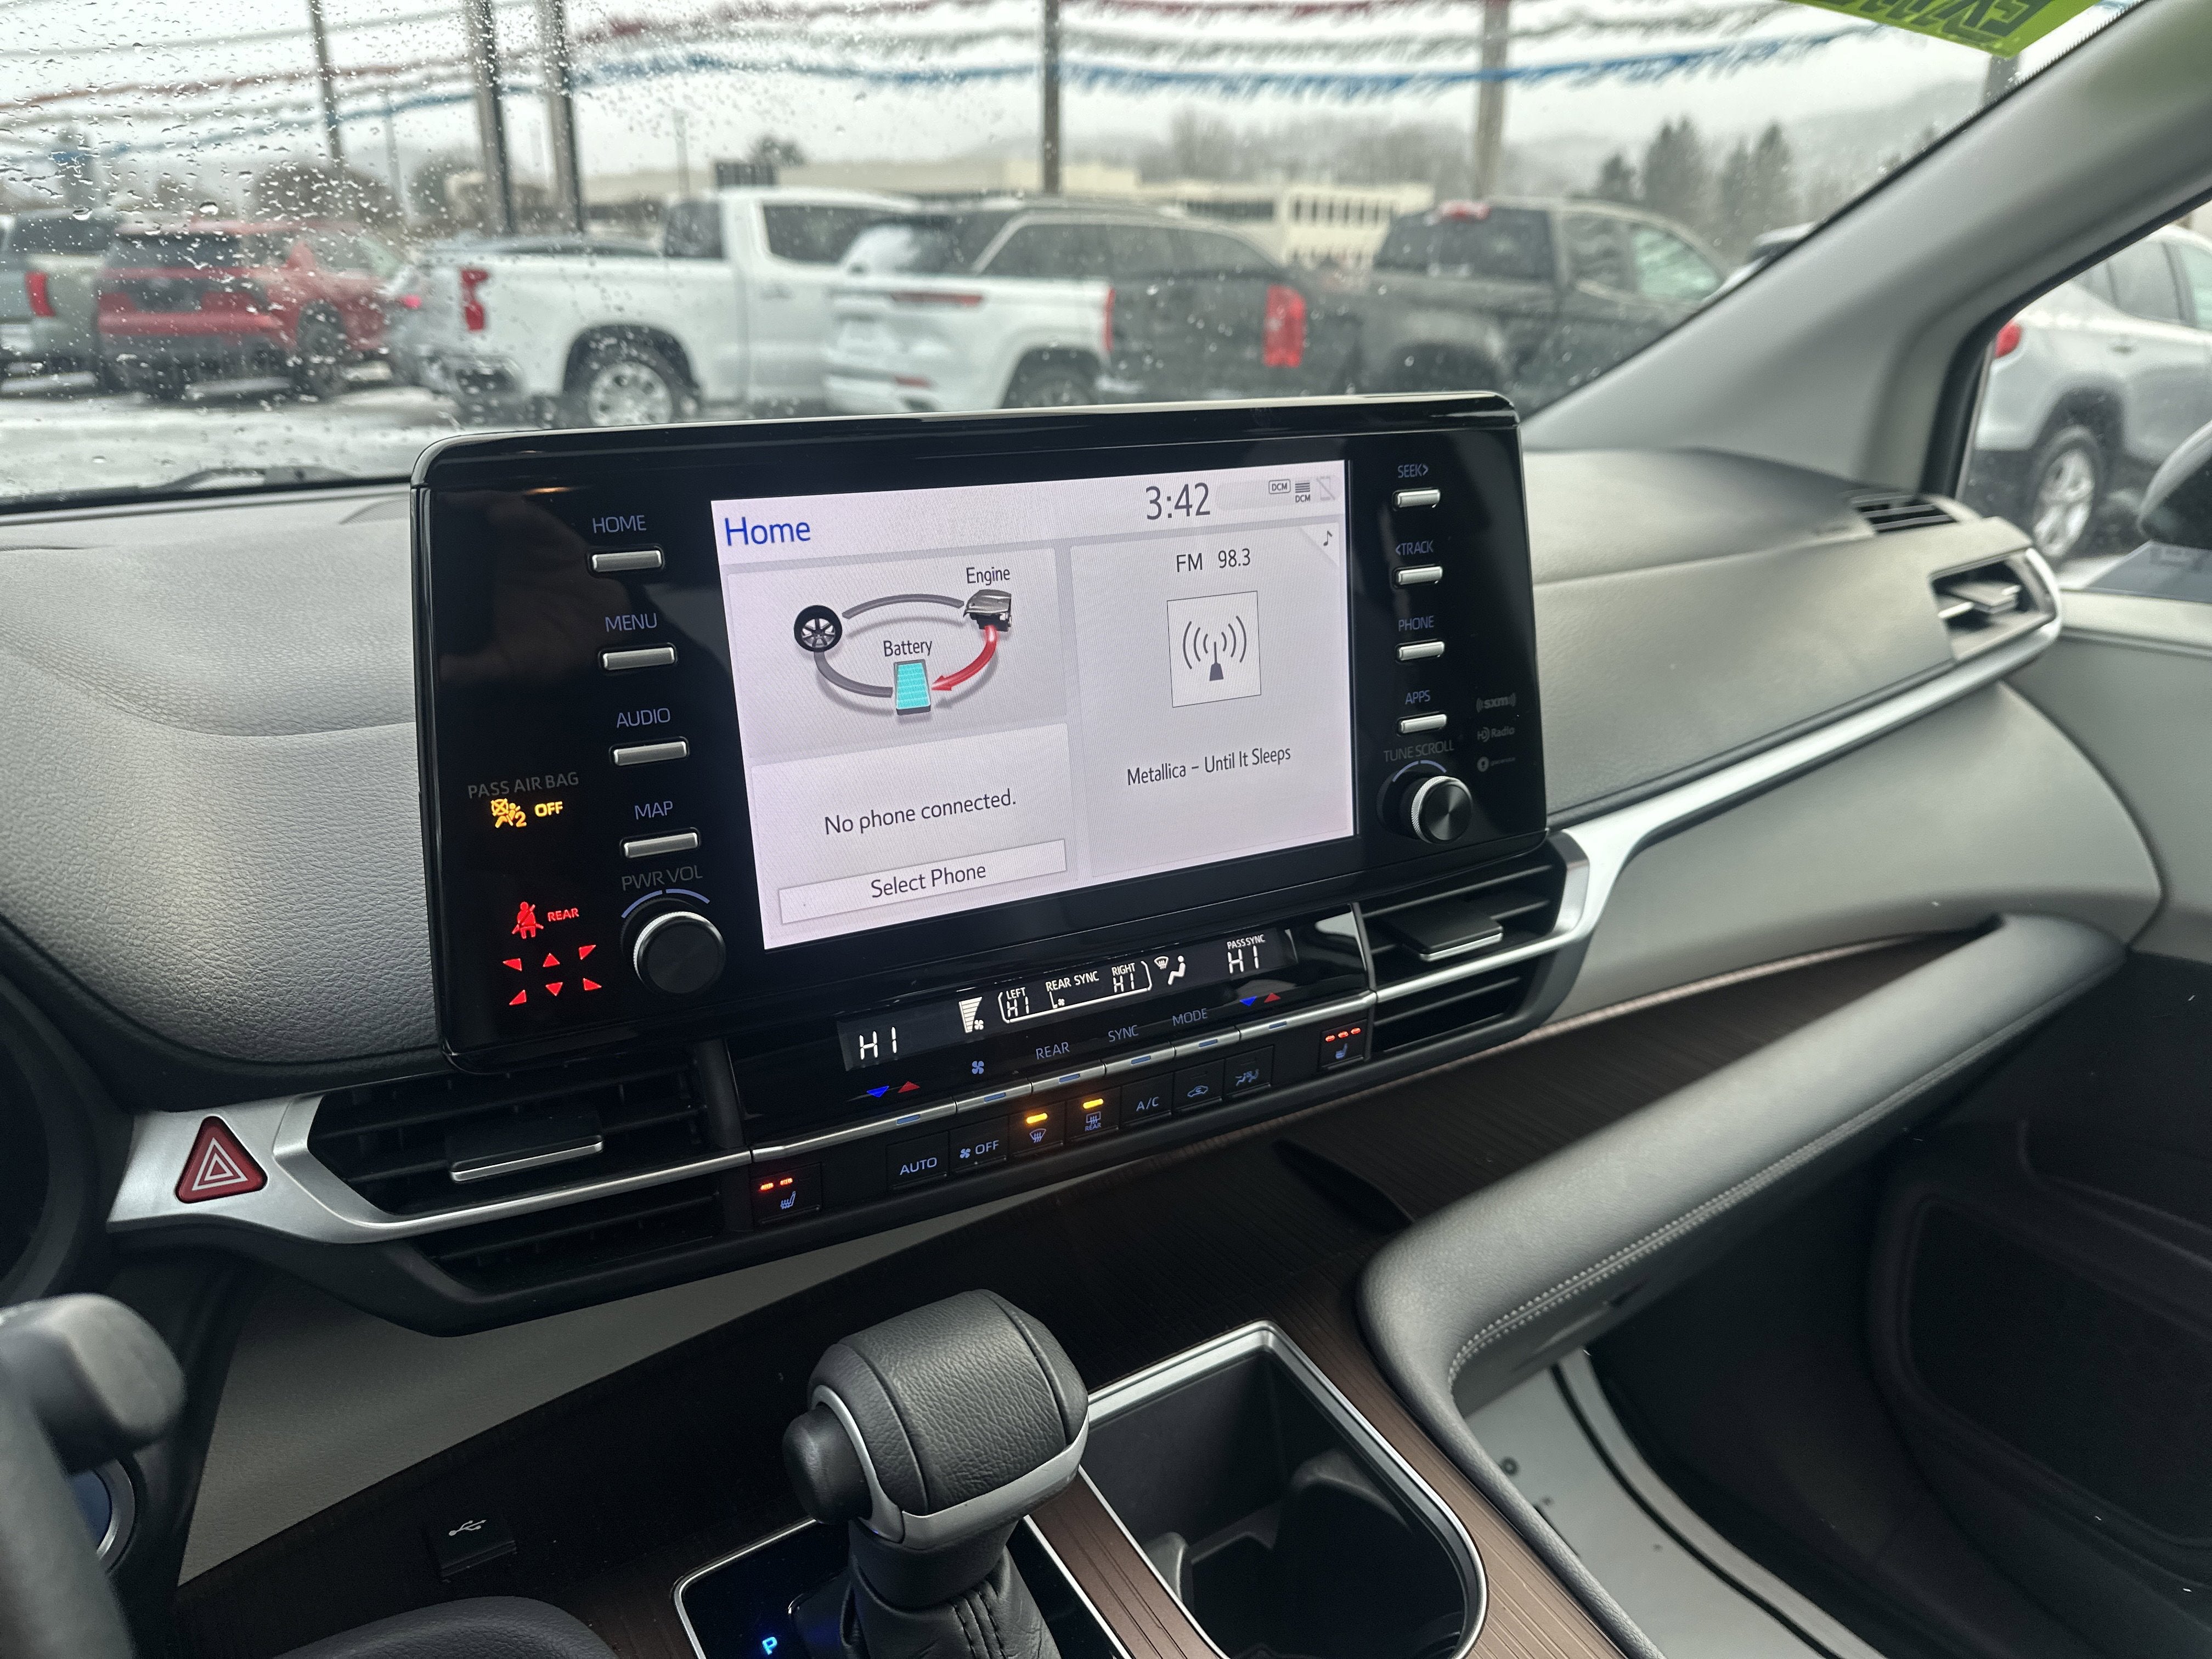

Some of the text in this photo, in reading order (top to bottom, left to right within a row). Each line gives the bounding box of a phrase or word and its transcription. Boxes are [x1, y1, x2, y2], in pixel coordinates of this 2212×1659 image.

[1272, 483, 1287, 491] DCM
[1146, 483, 1210, 520] 3:42
[1295, 494, 1310, 503] DCM
[593, 515, 646, 533] HOME
[725, 517, 810, 546] Home
[1177, 548, 1250, 572] FM 98.3
[966, 567, 1010, 585] Engine
[605, 613, 657, 631] MENU
[1398, 616, 1434, 631] PHONE
[883, 640, 932, 657] Battery
[1405, 690, 1430, 704] APPS
[617, 708, 670, 727] AUDIO
[1491, 726, 1515, 737] Radio
[1384, 740, 1454, 762] TUNE SCROLL
[1127, 763, 1186, 785] Metallica
[1205, 753, 1234, 772] Until
[1239, 751, 1248, 767] It
[1252, 748, 1290, 765] Sleeps
[468, 772, 578, 798] PASS AIR BAG
[535, 802, 563, 816] OFF
[635, 801, 673, 819] MAP
[825, 788, 1015, 834] No phone connected.
[622, 865, 703, 890] PWR VOL
[871, 866, 985, 898] Select Phone
[548, 908, 579, 922] REAR
[1227, 934, 1265, 950] PASS SYNC
[1228, 945, 1259, 973] HI
[1111, 963, 1135, 975] RIGHT
[1046, 971, 1099, 991] REAR SYNC
[1113, 972, 1135, 993] HI
[1006, 987, 1026, 1000] LEFT
[1006, 996, 1030, 1017] HI
[1172, 1008, 1207, 1026] MODE
[1108, 1025, 1138, 1042] SYNC
[860, 1027, 896, 1059] HI
[1036, 1042, 1069, 1059] REAR
[1136, 1097, 1158, 1111] A/C
[1085, 1122, 1101, 1131] REAR
[975, 1141, 998, 1154] OFF
[900, 1158, 936, 1175] AUTO
[763, 1637, 777, 1655] P
